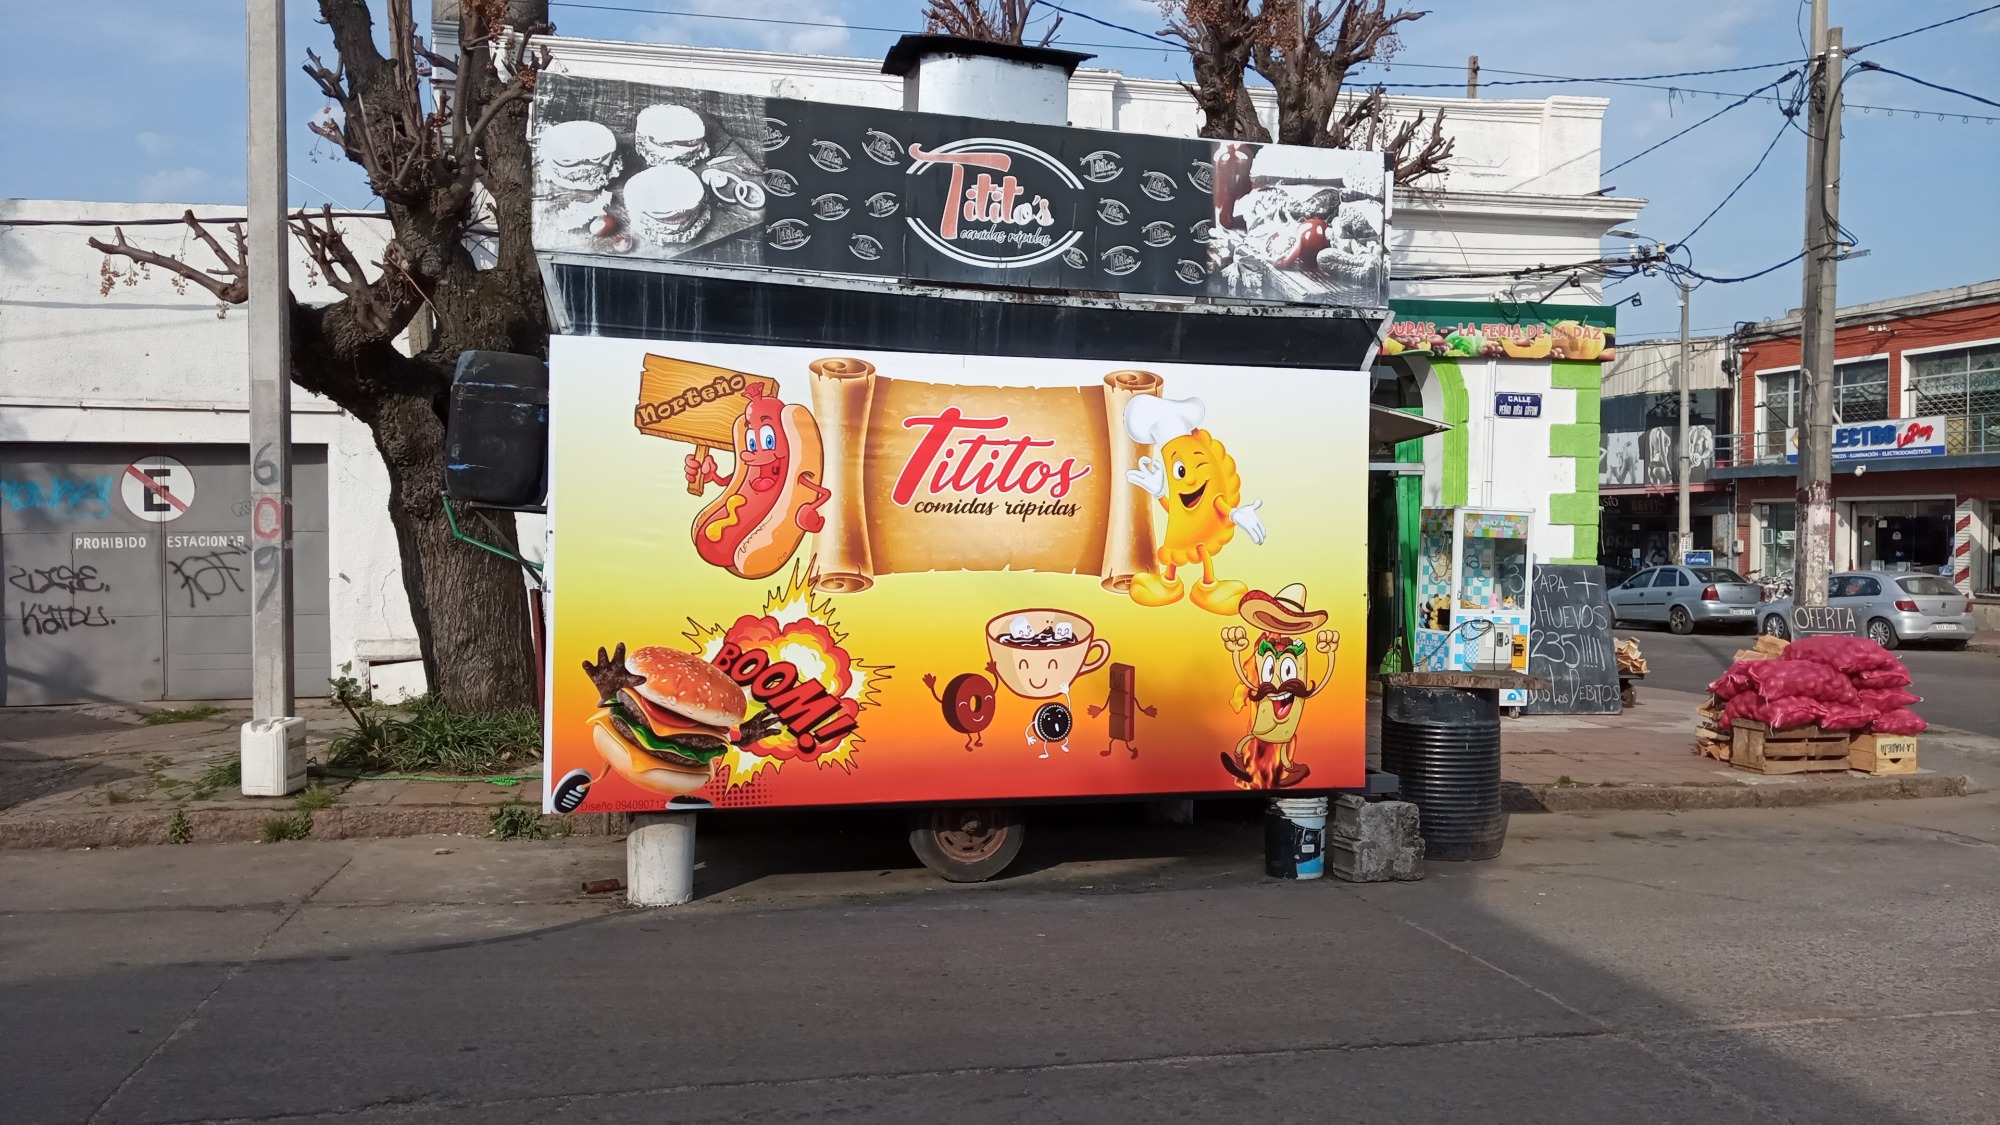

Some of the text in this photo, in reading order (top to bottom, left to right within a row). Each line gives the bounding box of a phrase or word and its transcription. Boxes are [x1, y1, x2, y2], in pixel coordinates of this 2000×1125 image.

[908, 143, 1055, 239] Titito's
[960, 224, 1052, 249] comidas rápidas
[1458, 323, 1476, 337] LA
[1481, 323, 1521, 339] FERIA
[1527, 324, 1544, 338] DE
[1550, 325, 1568, 339] LA
[1573, 326, 1602, 340] PAZ
[892, 406, 1092, 507] Tititos
[143, 469, 171, 512] E
[914, 498, 1081, 522] comidas rápidas
[75, 535, 245, 549] PROHIBIDO ESTACIONAR
[1536, 595, 1608, 630] HUEVOS
[1794, 607, 1857, 630] OFERTA
[580, 801, 613, 811] Diseño
